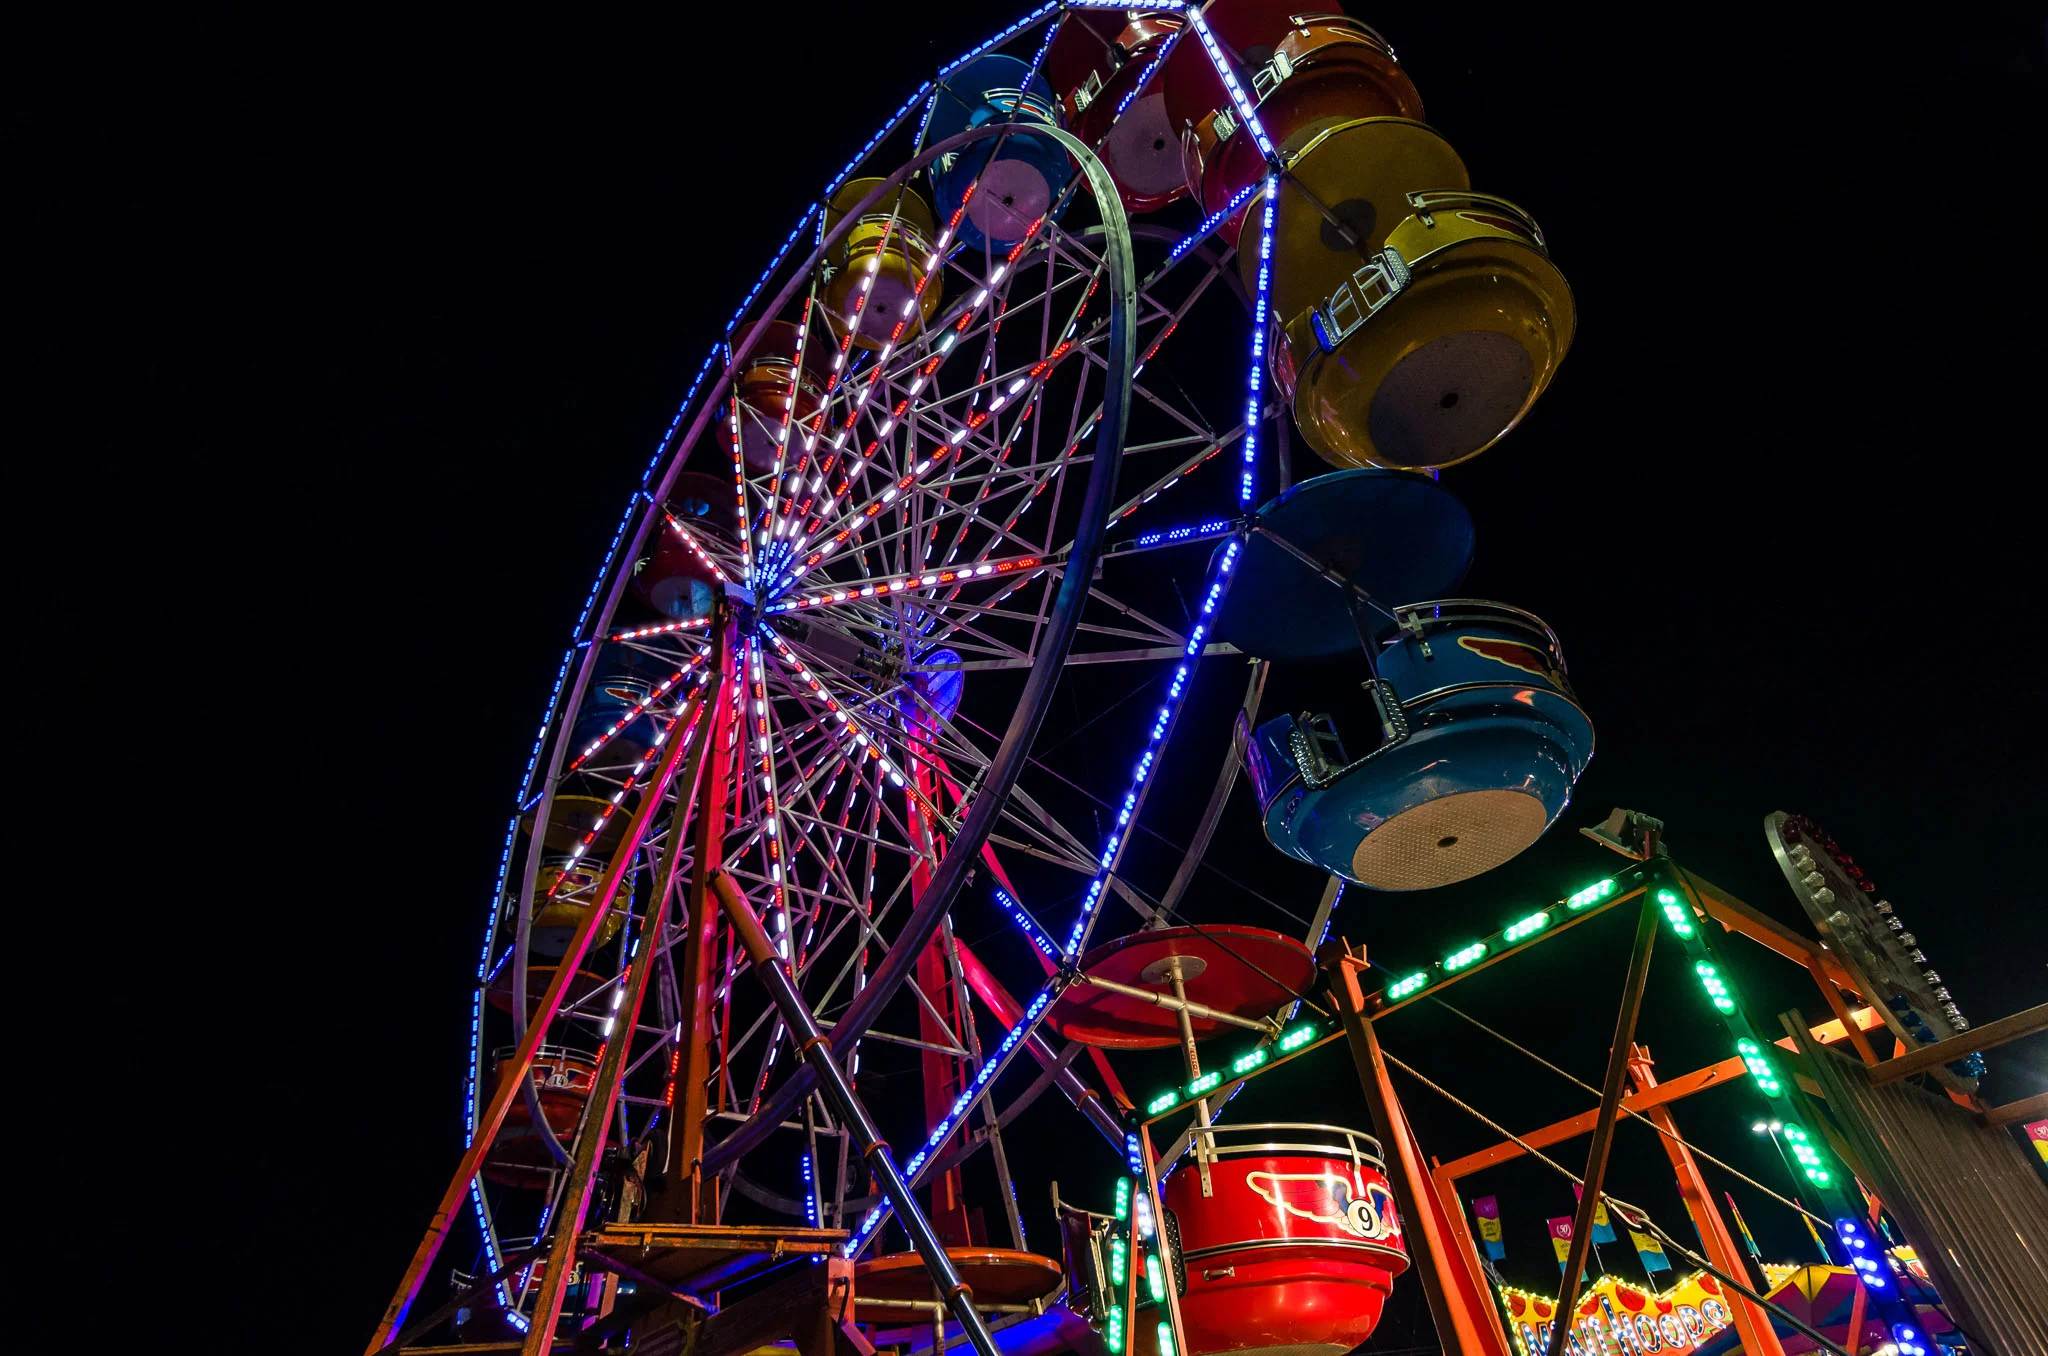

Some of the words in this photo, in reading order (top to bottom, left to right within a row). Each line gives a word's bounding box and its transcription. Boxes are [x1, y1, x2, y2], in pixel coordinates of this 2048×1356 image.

[1358, 1206, 1373, 1231] 9
[1521, 1315, 1610, 1356] MNI
[1600, 1295, 1727, 1356] HOOPS
